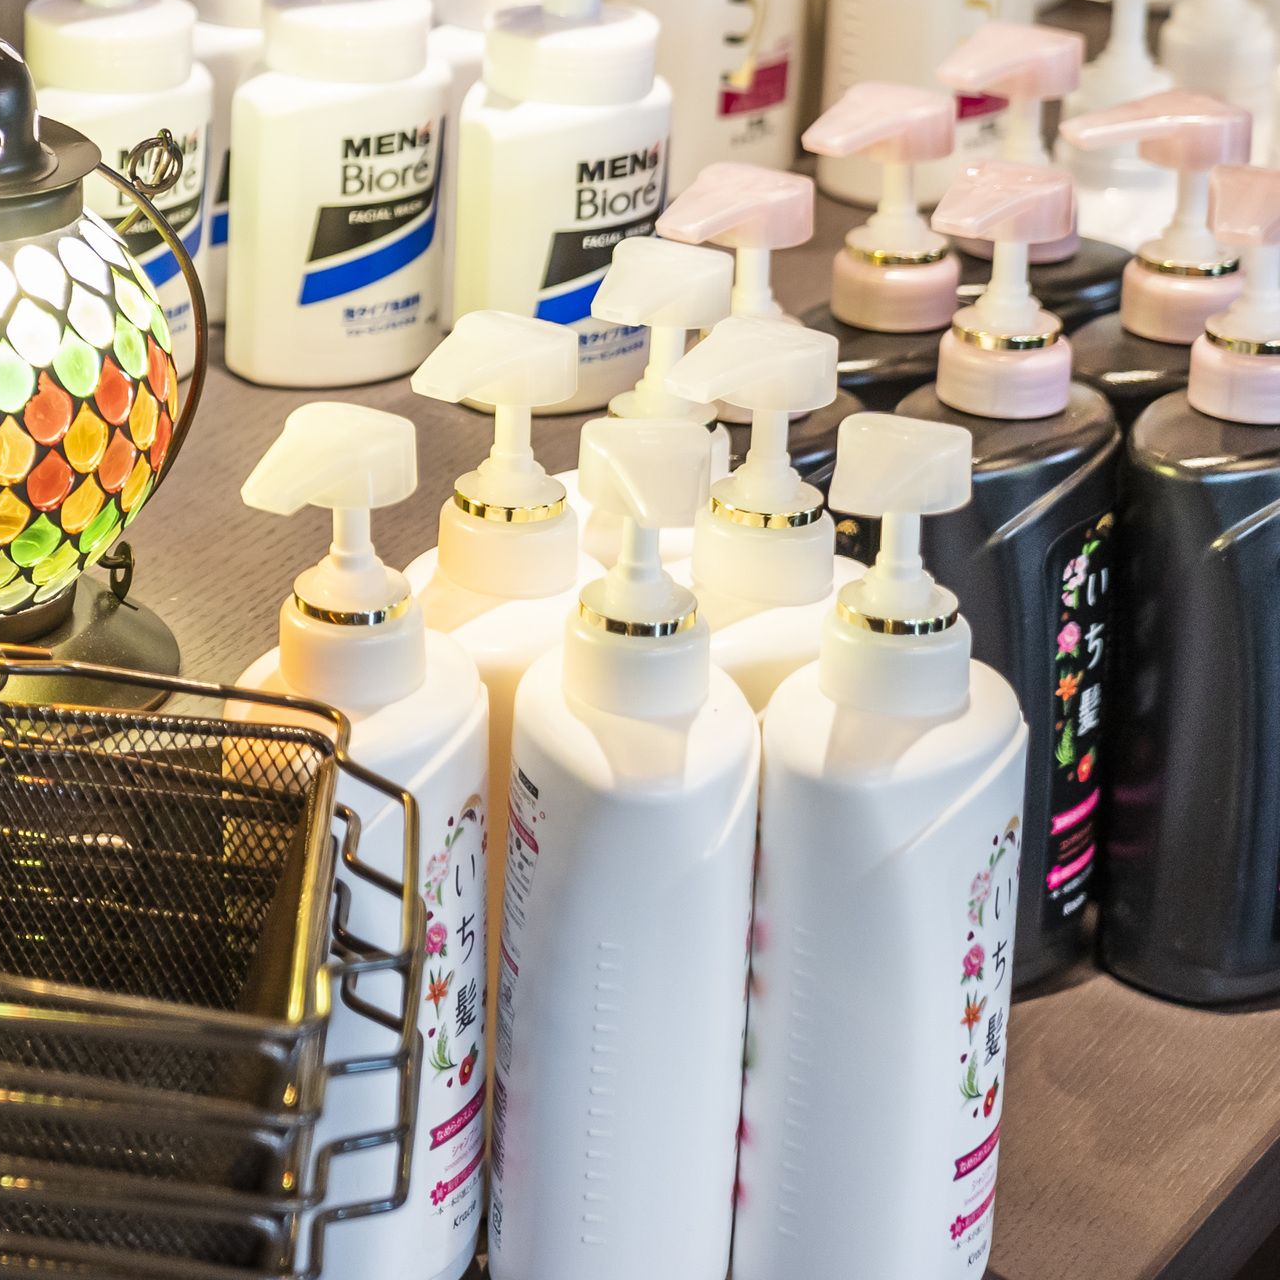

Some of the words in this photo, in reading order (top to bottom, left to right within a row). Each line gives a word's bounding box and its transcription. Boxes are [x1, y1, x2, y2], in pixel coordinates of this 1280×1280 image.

[348, 207, 391, 224] FACIAL
[582, 232, 624, 250] FACIAL
[455, 853, 477, 1038] いち髪
[984, 877, 1013, 1067] いち髪
